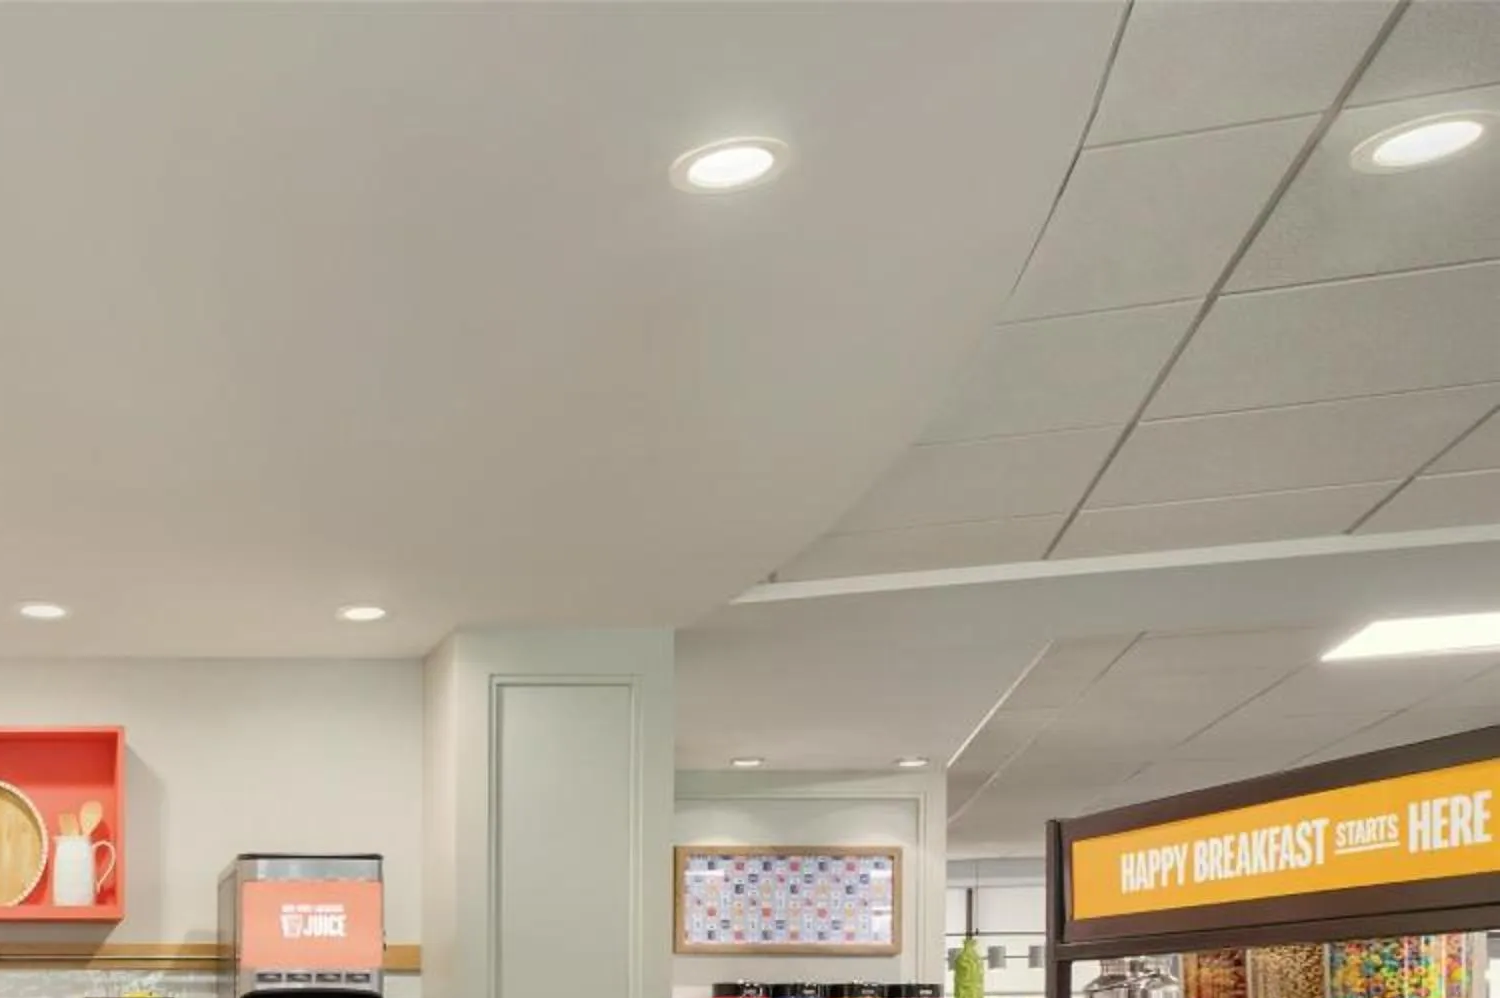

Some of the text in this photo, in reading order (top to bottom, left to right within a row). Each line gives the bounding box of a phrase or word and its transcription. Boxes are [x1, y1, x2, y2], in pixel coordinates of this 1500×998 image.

[1120, 790, 1493, 894] HAPPY BREAKFAST STARTS HERE
[303, 914, 348, 937] JUICE
